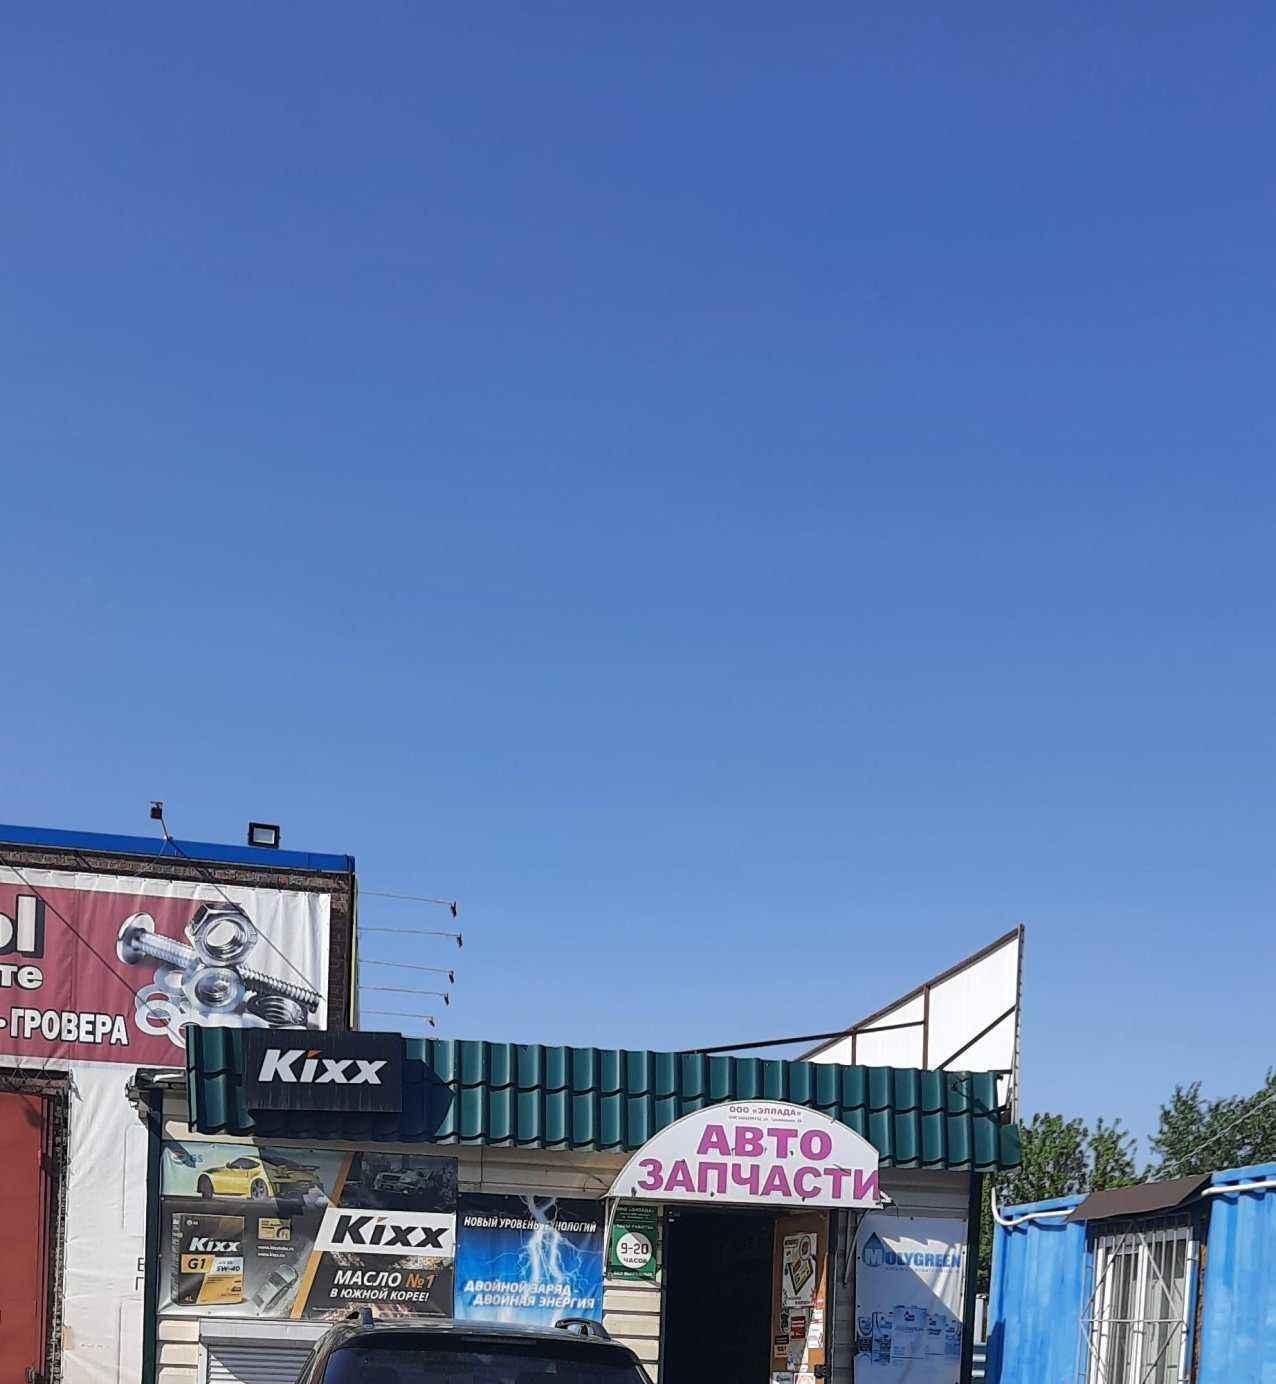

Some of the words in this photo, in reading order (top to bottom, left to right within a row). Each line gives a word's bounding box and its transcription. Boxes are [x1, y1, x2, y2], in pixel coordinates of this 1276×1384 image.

[10, 1007, 129, 1045] ГРОВЕРА
[258, 1049, 388, 1085] Kixx
[696, 1124, 833, 1161] АВТО
[637, 1158, 879, 1201] ЗАПЧАСТИ
[331, 1215, 450, 1248] Kixx
[464, 1216, 498, 1228] НОВЫЙ
[499, 1218, 539, 1230] УРОВЕНЬ
[540, 1220, 597, 1232] ЕНОЛОГИЙ
[188, 1237, 242, 1252] Kixx
[620, 1242, 649, 1254] 9-20
[187, 1258, 207, 1270] G1
[864, 1247, 961, 1268] MOLYGREEN
[334, 1270, 402, 1287] МАСЛО
[330, 1288, 338, 1298] В
[340, 1288, 388, 1299] ЮЖНОЙ
[390, 1290, 430, 1302] КОРЕЕ!
[464, 1280, 529, 1294] ДВОЙНОЙ
[473, 1293, 535, 1307] ДВОЙНАЯ
[538, 1297, 596, 1309] ЭНЕРГИЯ
